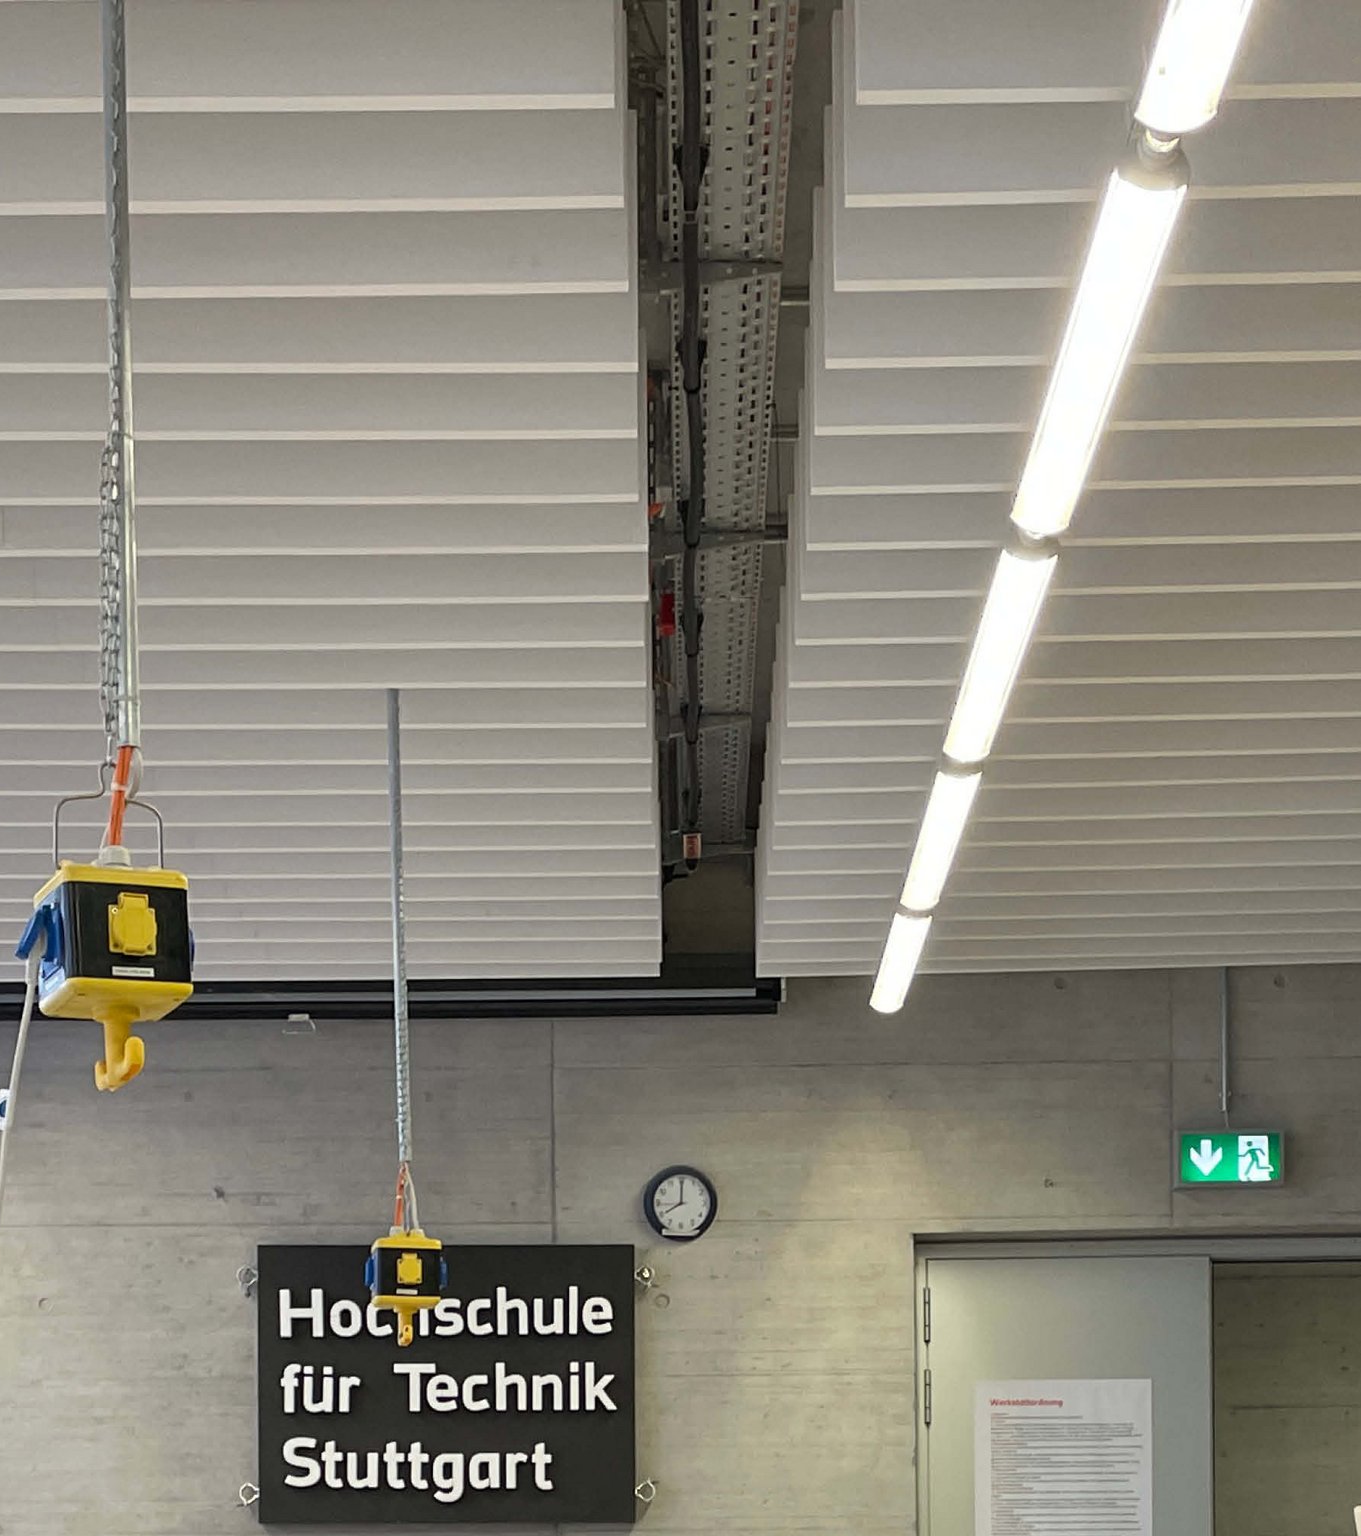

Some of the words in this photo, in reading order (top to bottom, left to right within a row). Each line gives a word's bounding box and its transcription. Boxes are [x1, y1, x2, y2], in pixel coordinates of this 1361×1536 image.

[280, 1363, 361, 1413] für
[393, 1361, 617, 1413] Technik
[282, 1436, 554, 1503] Stuttgart
